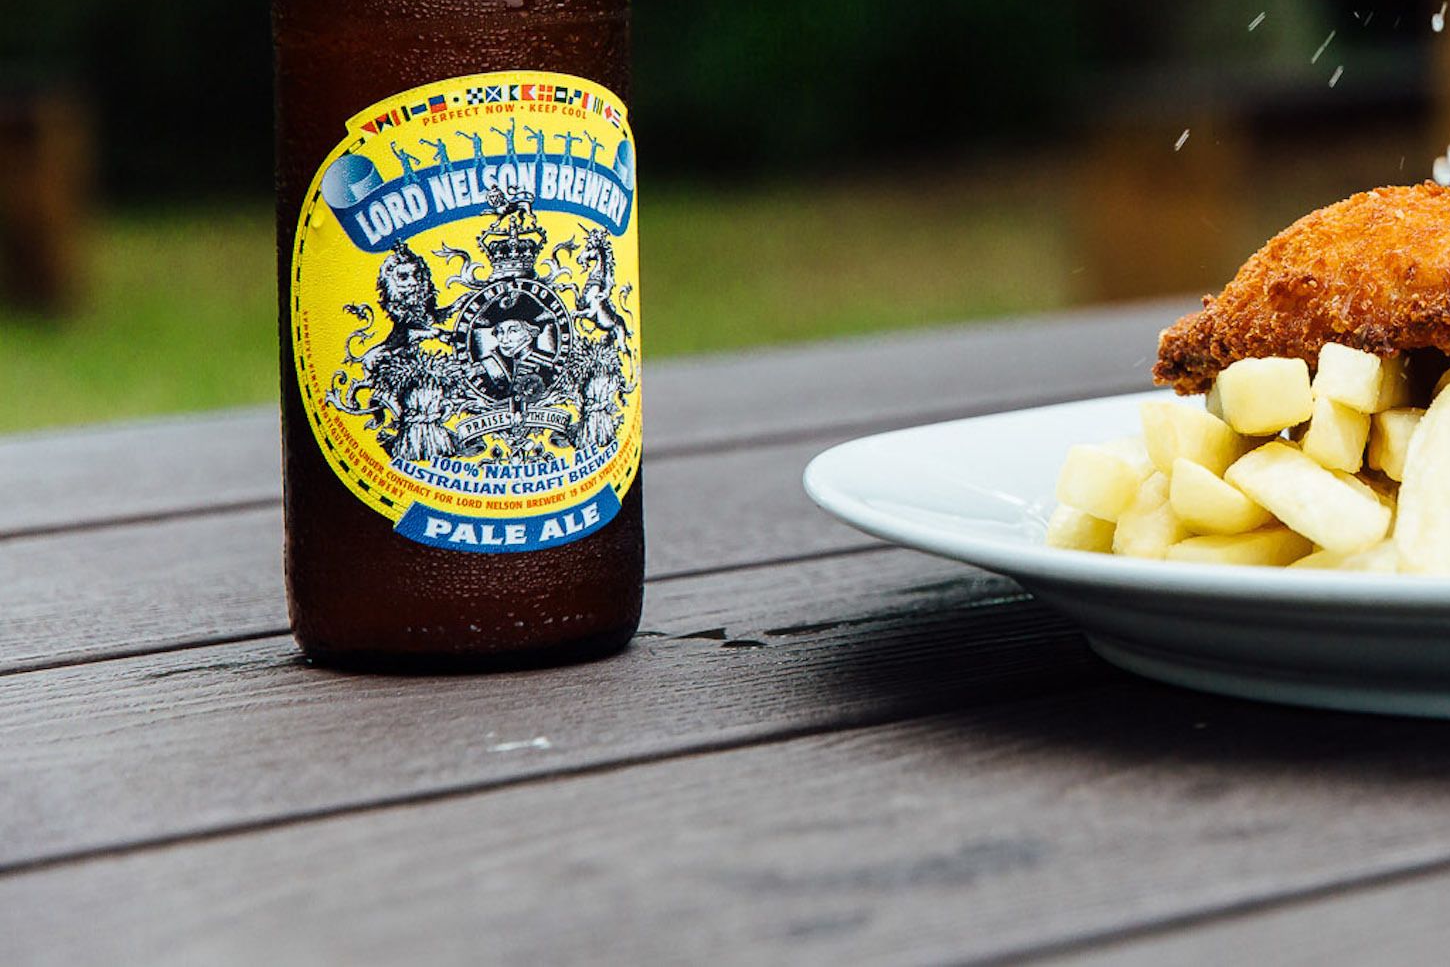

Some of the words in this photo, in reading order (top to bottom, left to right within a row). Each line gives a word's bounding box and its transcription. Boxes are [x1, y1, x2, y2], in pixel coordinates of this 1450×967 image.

[422, 107, 480, 126] PERFECT
[485, 104, 515, 114] NOW
[529, 104, 558, 114] KEEP
[562, 107, 588, 120] COOL
[355, 183, 429, 246] LORD
[427, 161, 537, 213] NELSON
[540, 162, 628, 227] BREWERY
[531, 284, 548, 299] DO
[550, 299, 567, 325] HIS
[465, 414, 505, 434] PRAISE
[529, 411, 545, 421] THE
[334, 416, 359, 449] BREWED
[359, 449, 385, 475] UNDER
[386, 472, 431, 497] CONTRACT
[434, 491, 453, 504] FOR
[455, 498, 482, 509] LORD
[486, 501, 523, 510] NELSON
[526, 491, 566, 509] BREWERY
[580, 478, 598, 494] KENT
[344, 447, 360, 466] PUB
[391, 457, 506, 494] AUSTRALIAN
[511, 475, 565, 494] CRAFT
[568, 441, 618, 483] BREWED
[431, 455, 479, 477] 100%
[485, 458, 570, 479] NATURAL
[574, 442, 599, 466] ALE
[422, 515, 528, 546] PALE
[538, 501, 601, 542] ALE
